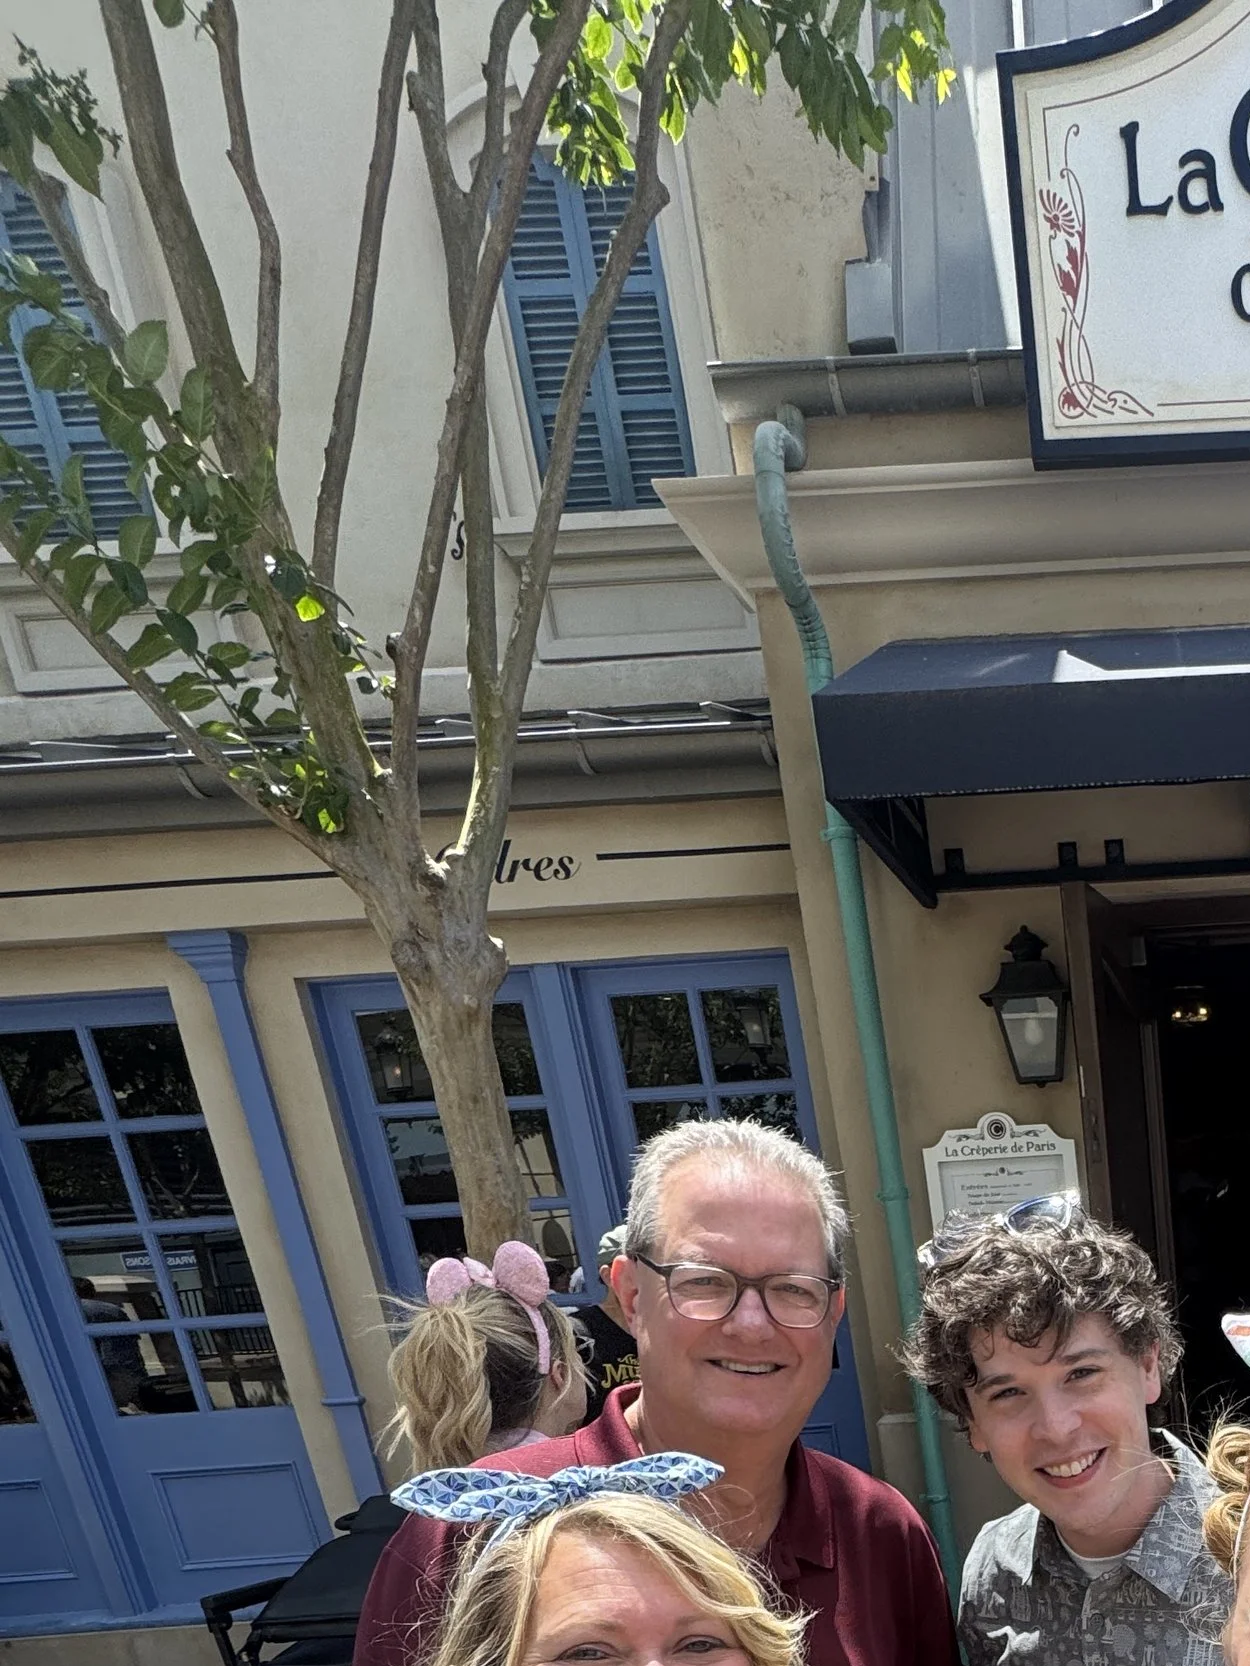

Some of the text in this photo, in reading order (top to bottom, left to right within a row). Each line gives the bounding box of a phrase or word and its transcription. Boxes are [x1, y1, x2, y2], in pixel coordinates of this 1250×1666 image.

[1119, 121, 1225, 218] La
[944, 1146, 958, 1157] La
[1011, 1141, 1024, 1153] de
[1025, 1140, 1057, 1152] Paris
